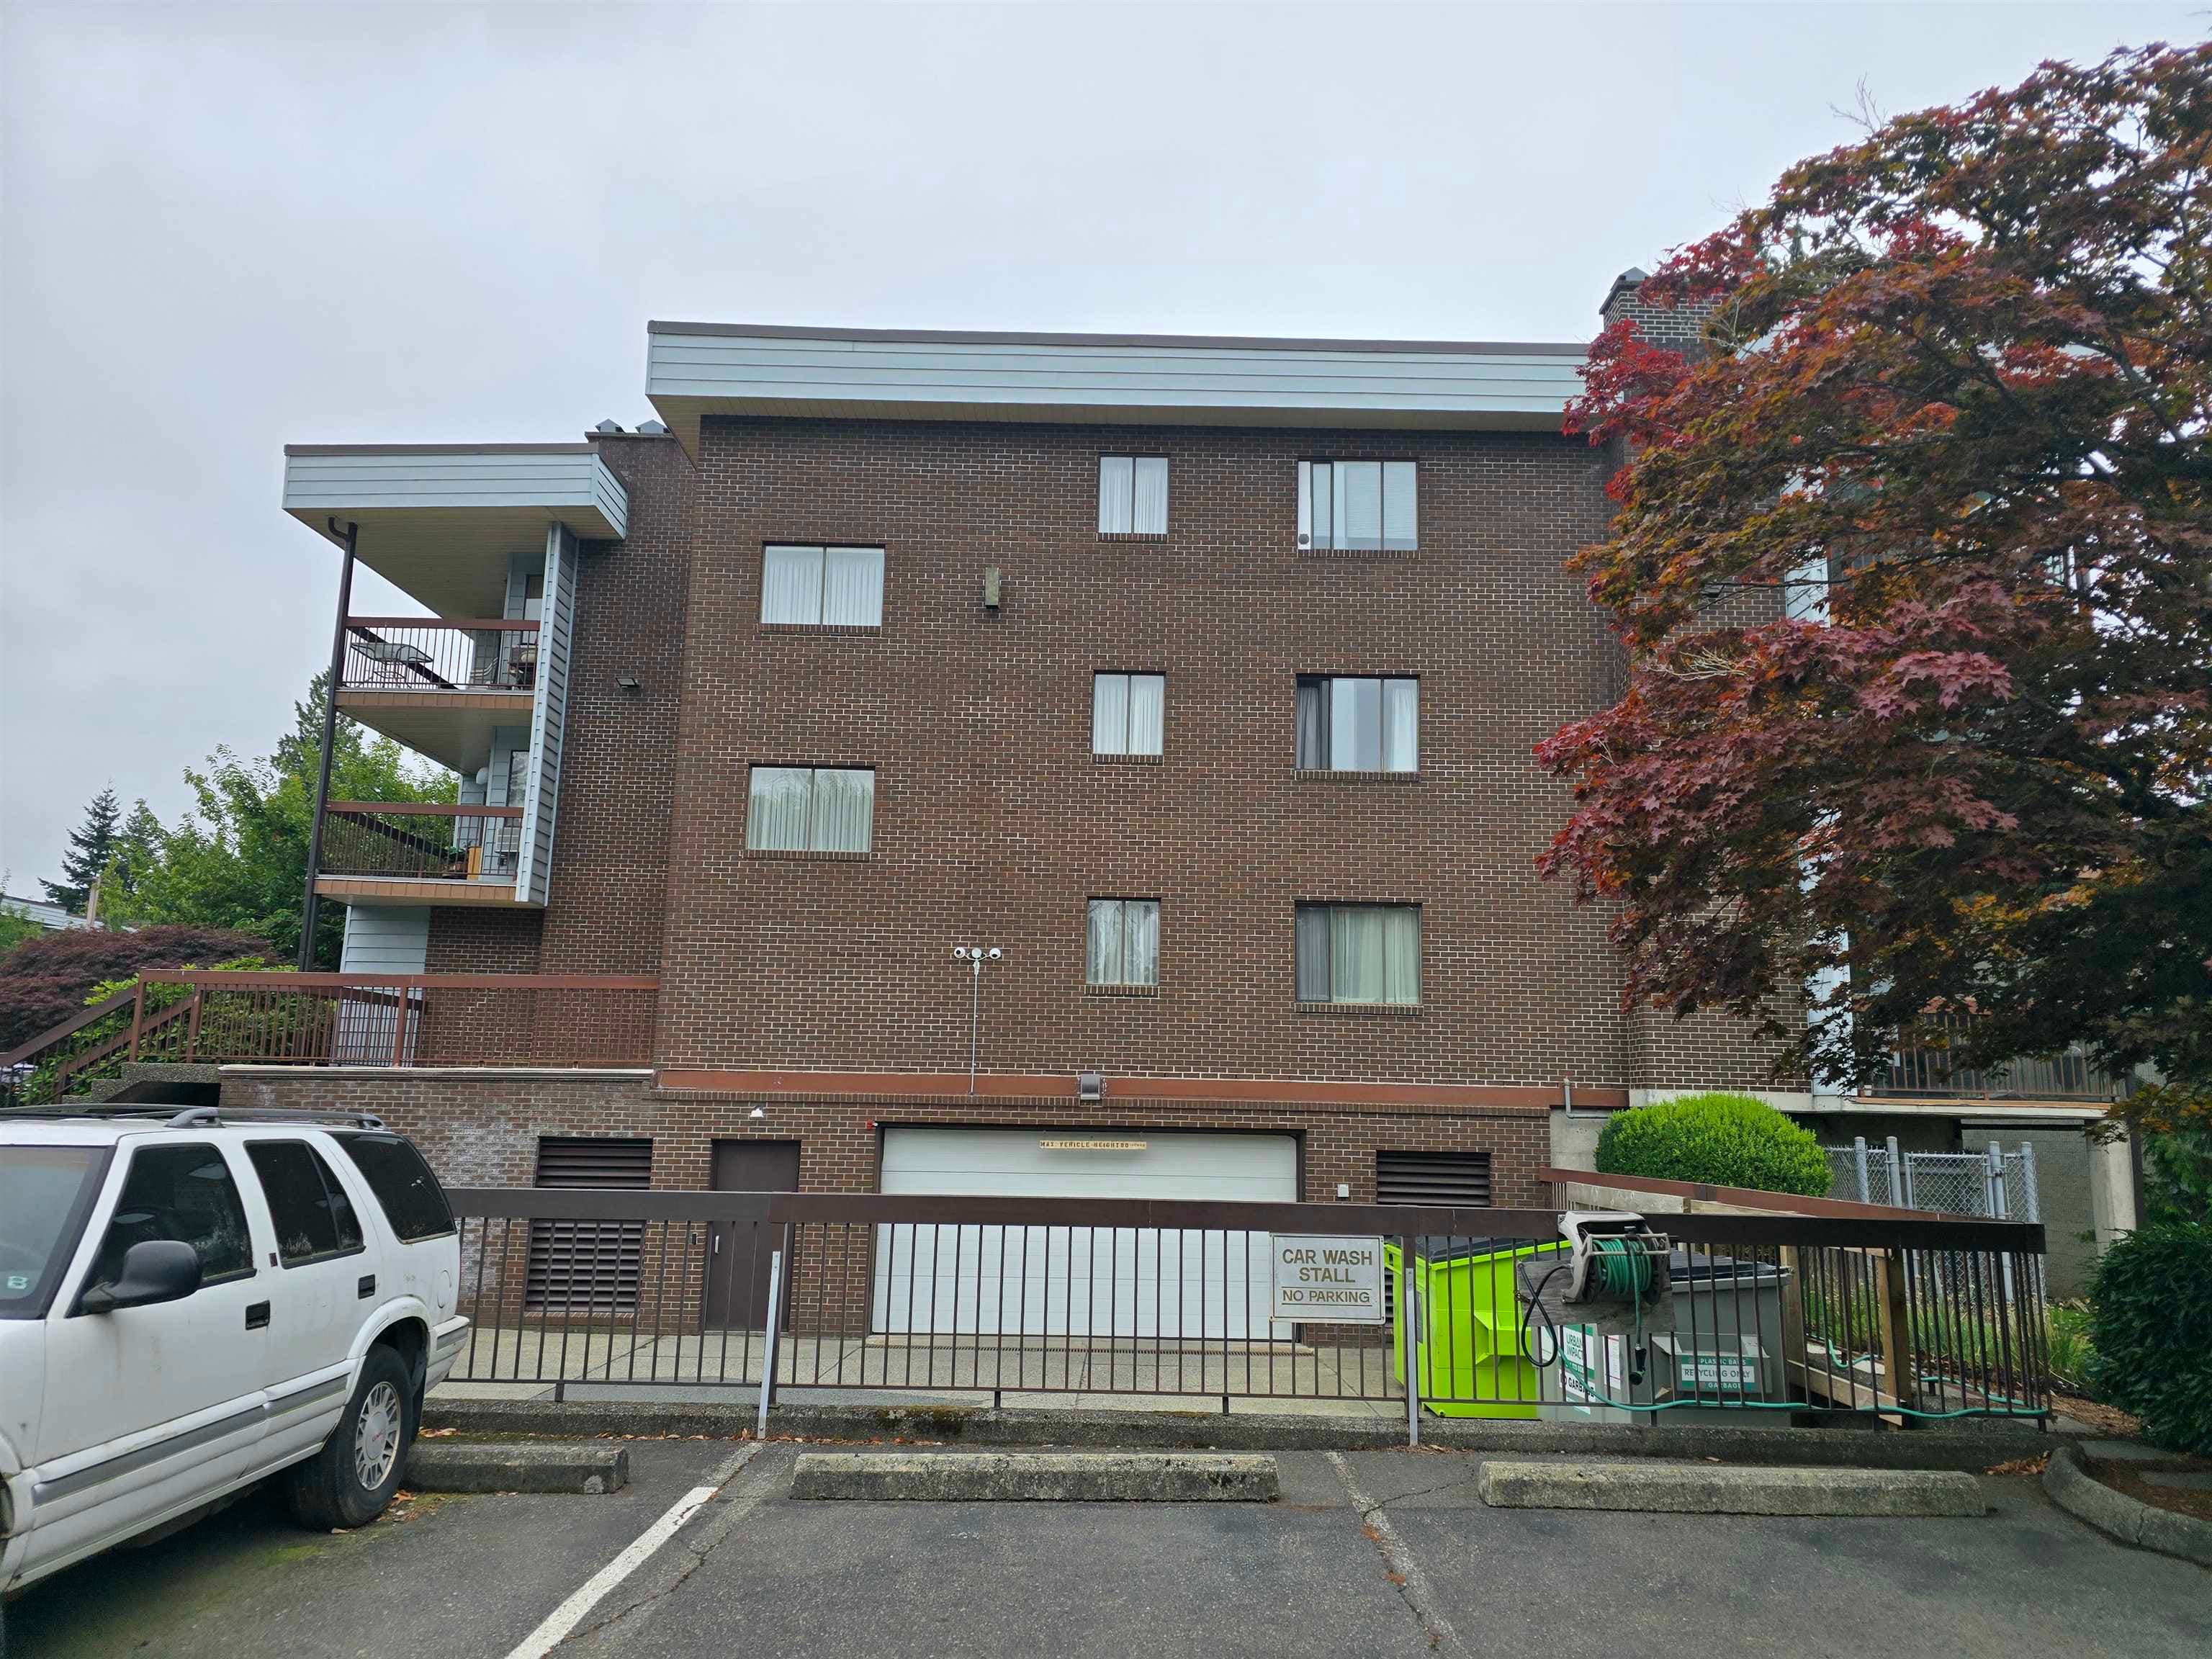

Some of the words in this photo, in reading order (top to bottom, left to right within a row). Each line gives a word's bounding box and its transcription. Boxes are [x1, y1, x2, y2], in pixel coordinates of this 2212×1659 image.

[1282, 1249, 1316, 1264] CAR
[1323, 1249, 1372, 1265] WASH
[1299, 1267, 1356, 1282] STALL
[1282, 1290, 1303, 1302] NO
[1309, 1290, 1370, 1303] PARKING
[1566, 1344, 1583, 1360] IMPAC
[1684, 1369, 1727, 1377] REYCLIG
[1568, 1377, 1594, 1398] GARB
